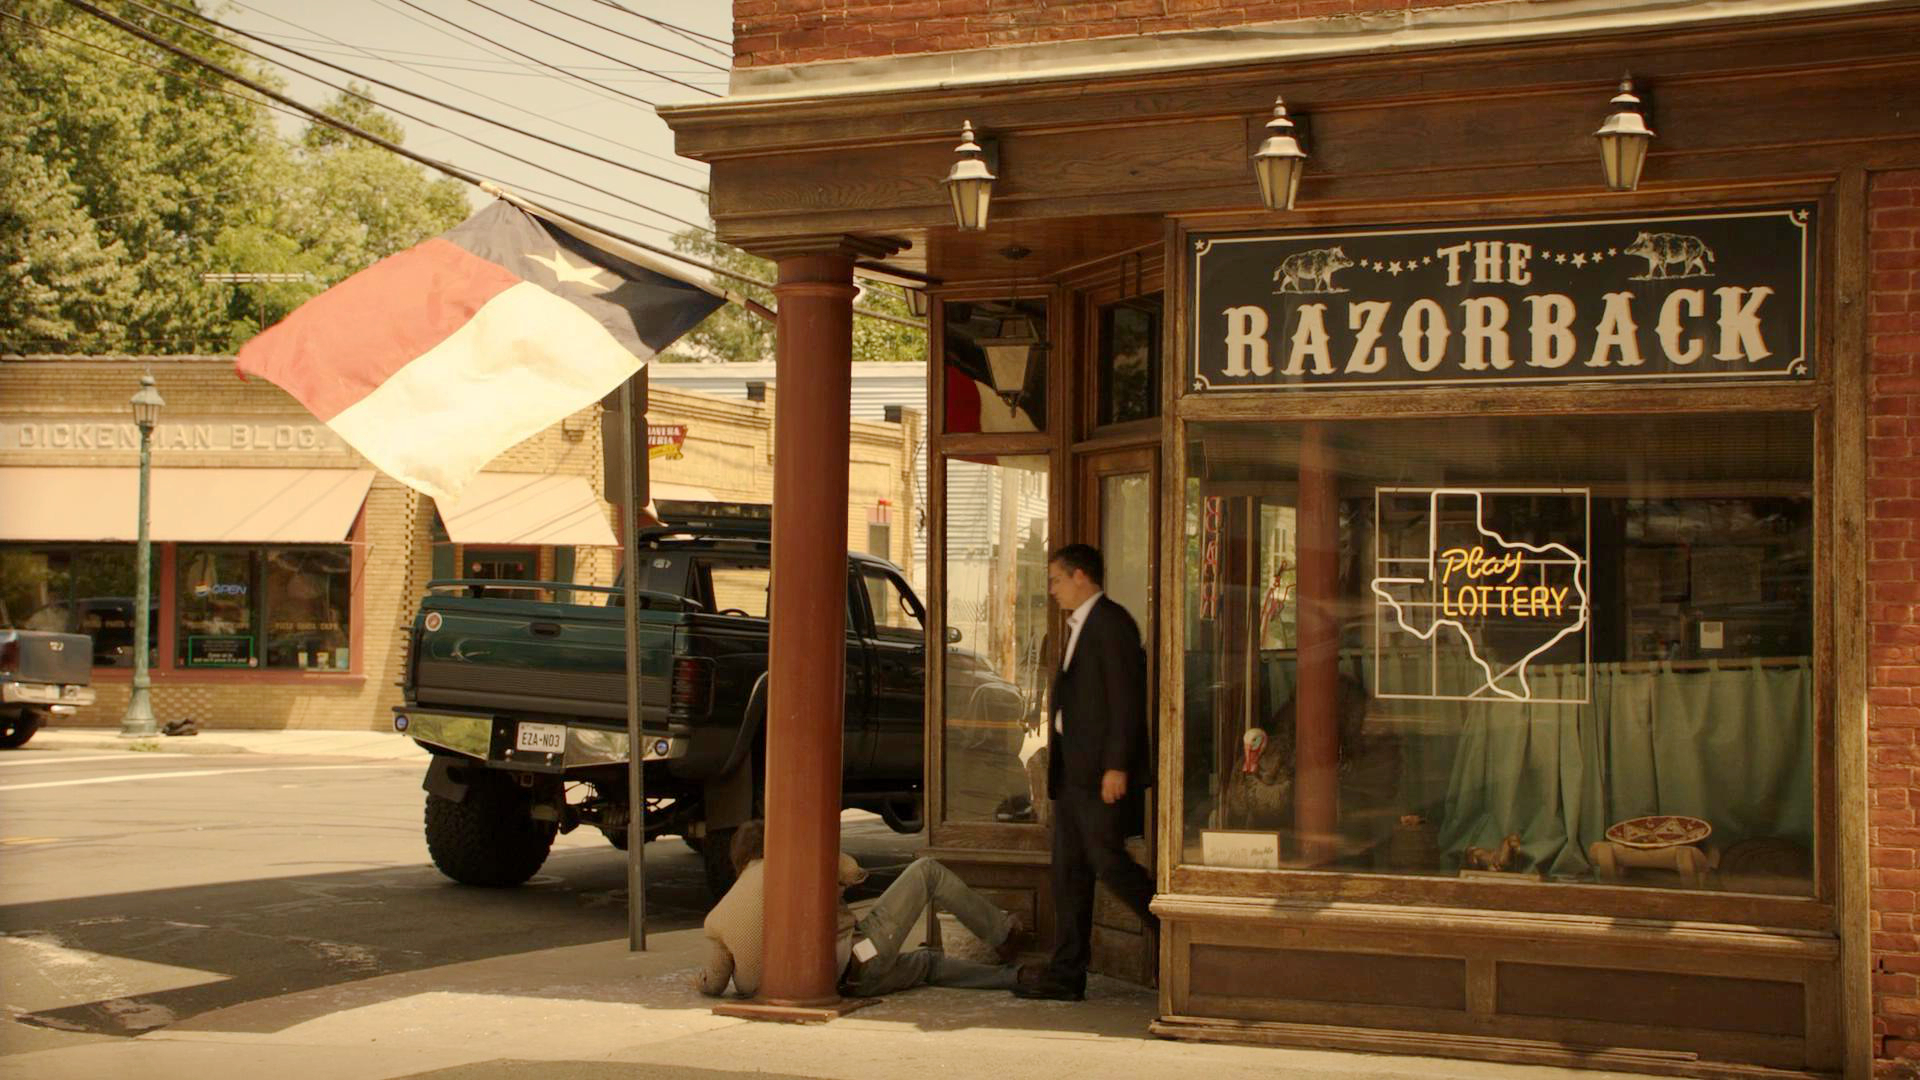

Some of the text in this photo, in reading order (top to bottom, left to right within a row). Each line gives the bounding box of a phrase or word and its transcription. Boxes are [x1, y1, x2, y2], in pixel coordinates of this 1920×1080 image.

[1437, 241, 1533, 287] THE
[1222, 287, 1774, 377] RAZORBACK
[230, 423, 326, 450] BLDG.
[1441, 546, 1522, 584] Play
[211, 584, 247, 595] OPEN
[1443, 585, 1569, 617] LOTTERY
